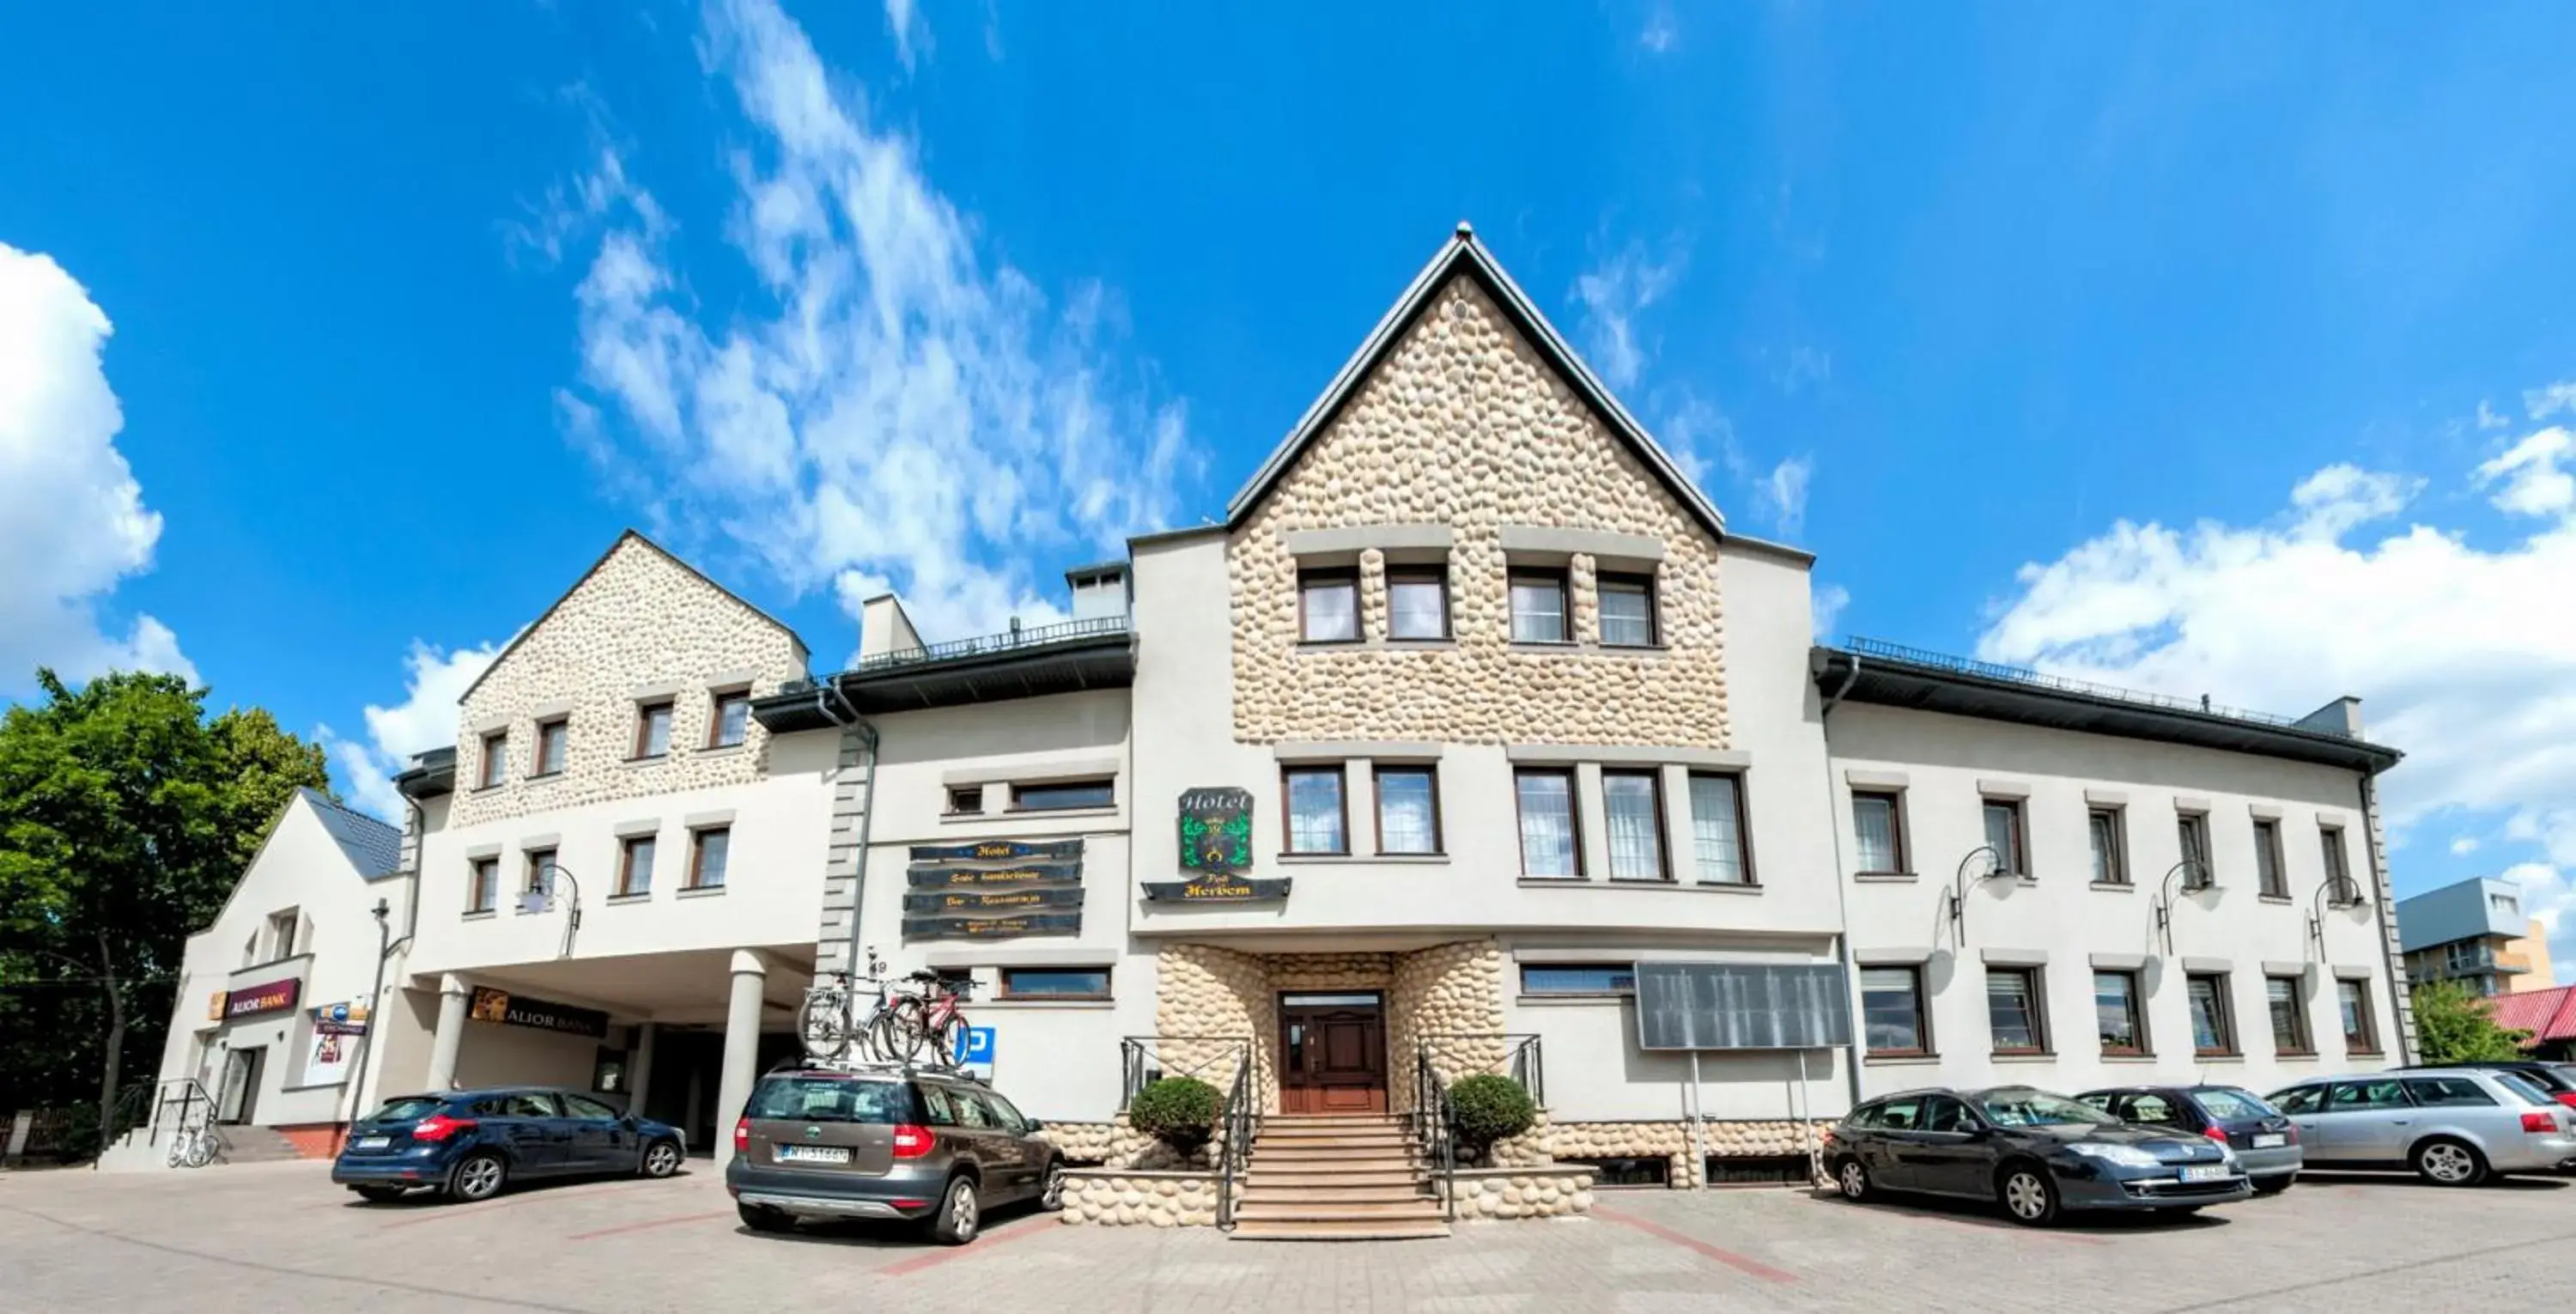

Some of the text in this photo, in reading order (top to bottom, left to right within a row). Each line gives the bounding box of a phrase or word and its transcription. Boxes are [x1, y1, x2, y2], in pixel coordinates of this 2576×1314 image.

[1186, 793, 1247, 811] Hotel
[1185, 884, 1251, 898] Herbem
[231, 991, 288, 1013] ALIOR BANK
[507, 1009, 555, 1027] ALIOR
